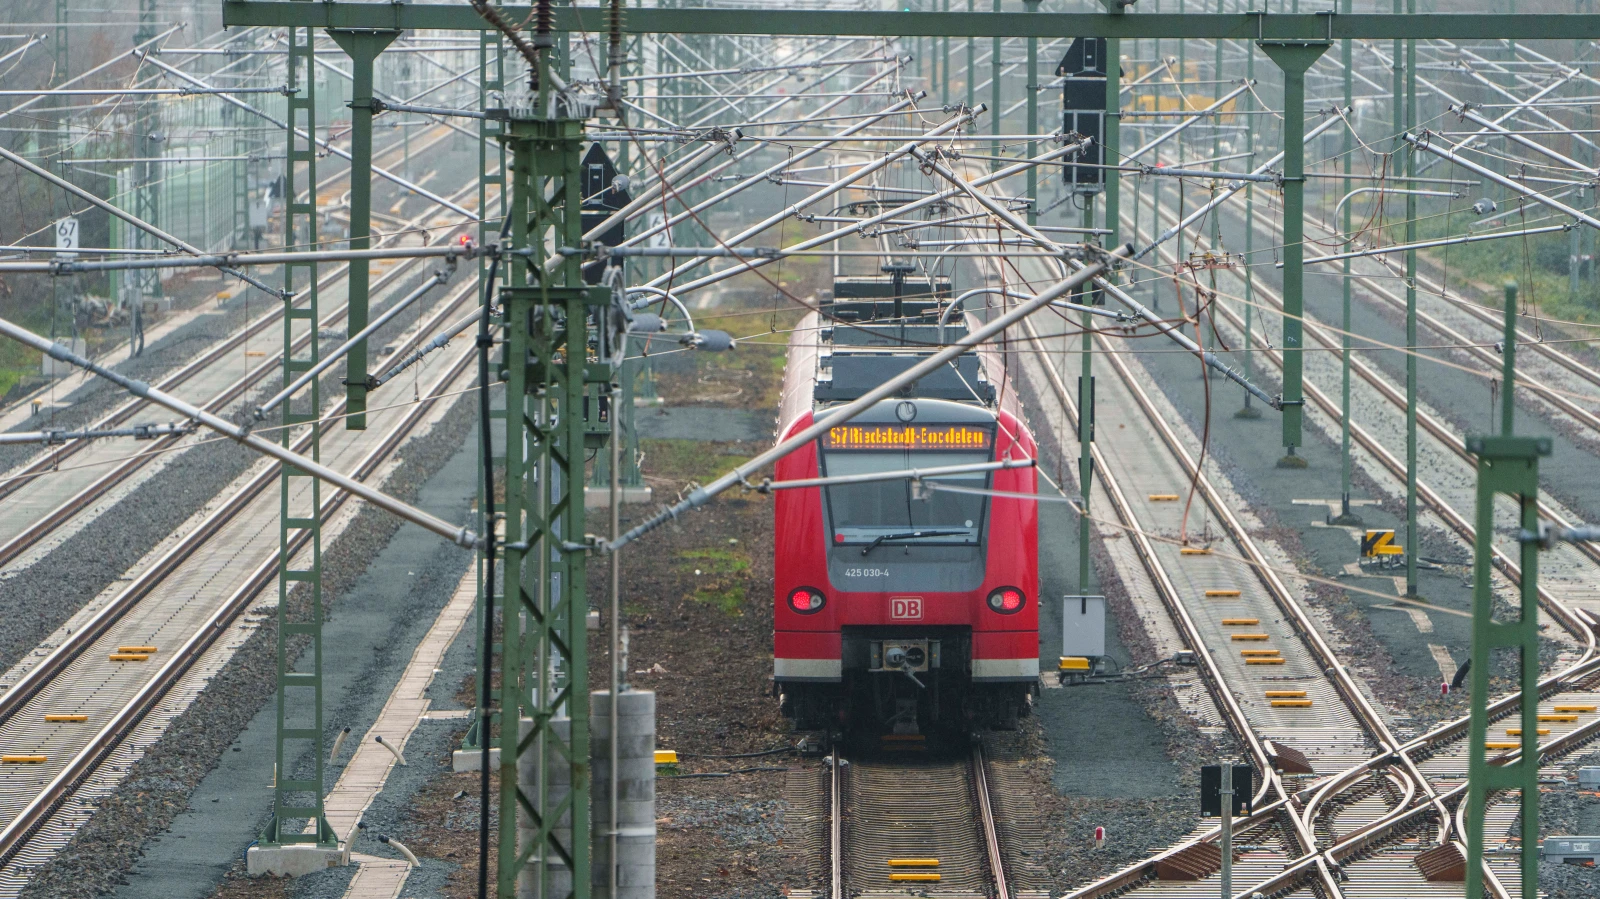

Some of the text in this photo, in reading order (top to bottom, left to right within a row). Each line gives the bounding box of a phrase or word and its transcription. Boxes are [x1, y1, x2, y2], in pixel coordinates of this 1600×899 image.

[58, 221, 76, 236] 67
[63, 237, 72, 248] 2
[657, 233, 666, 247] 2
[830, 426, 848, 445] S7
[844, 568, 890, 577] 425 030-4
[893, 600, 920, 617] DB
